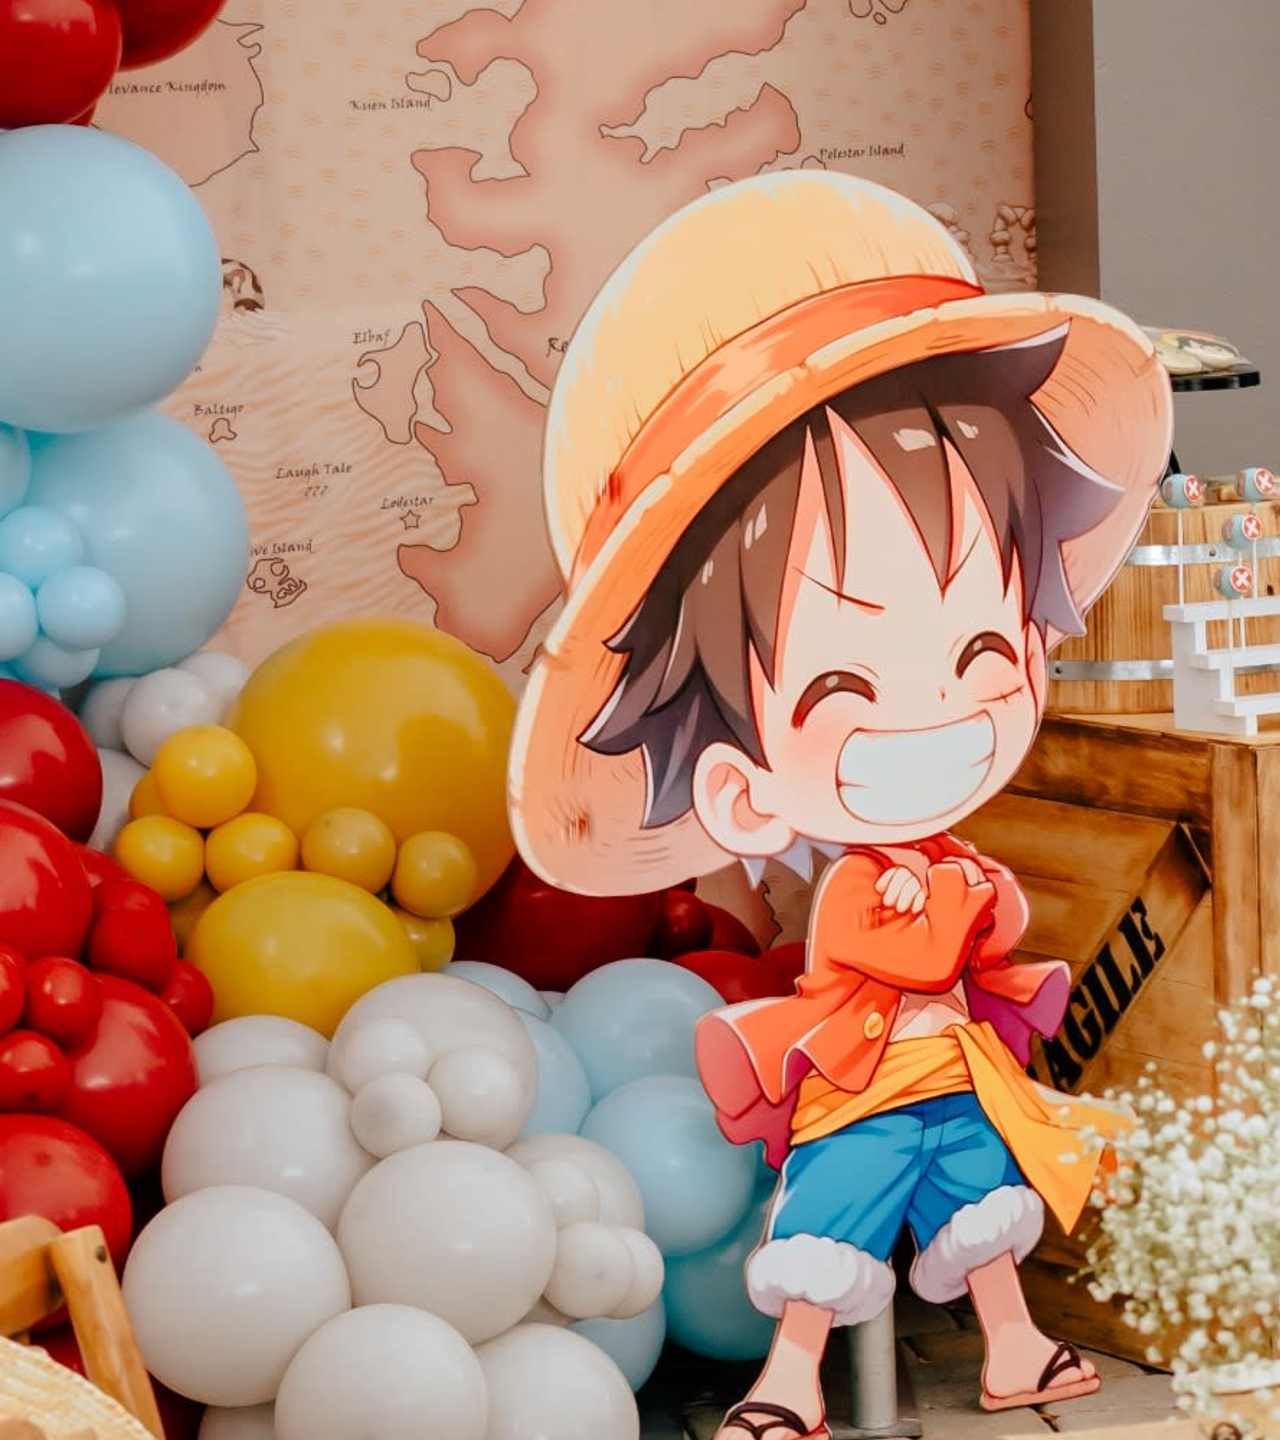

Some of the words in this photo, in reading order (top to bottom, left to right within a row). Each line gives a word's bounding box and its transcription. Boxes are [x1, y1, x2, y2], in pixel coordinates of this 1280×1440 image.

[166, 80, 227, 97] Kingdom
[391, 97, 432, 111] Island
[869, 143, 905, 157] Island
[352, 330, 389, 347] Elbaf
[193, 403, 244, 419] Baltigo
[276, 464, 320, 480] Laugh
[324, 463, 352, 477] Tale
[272, 539, 315, 554] Island
